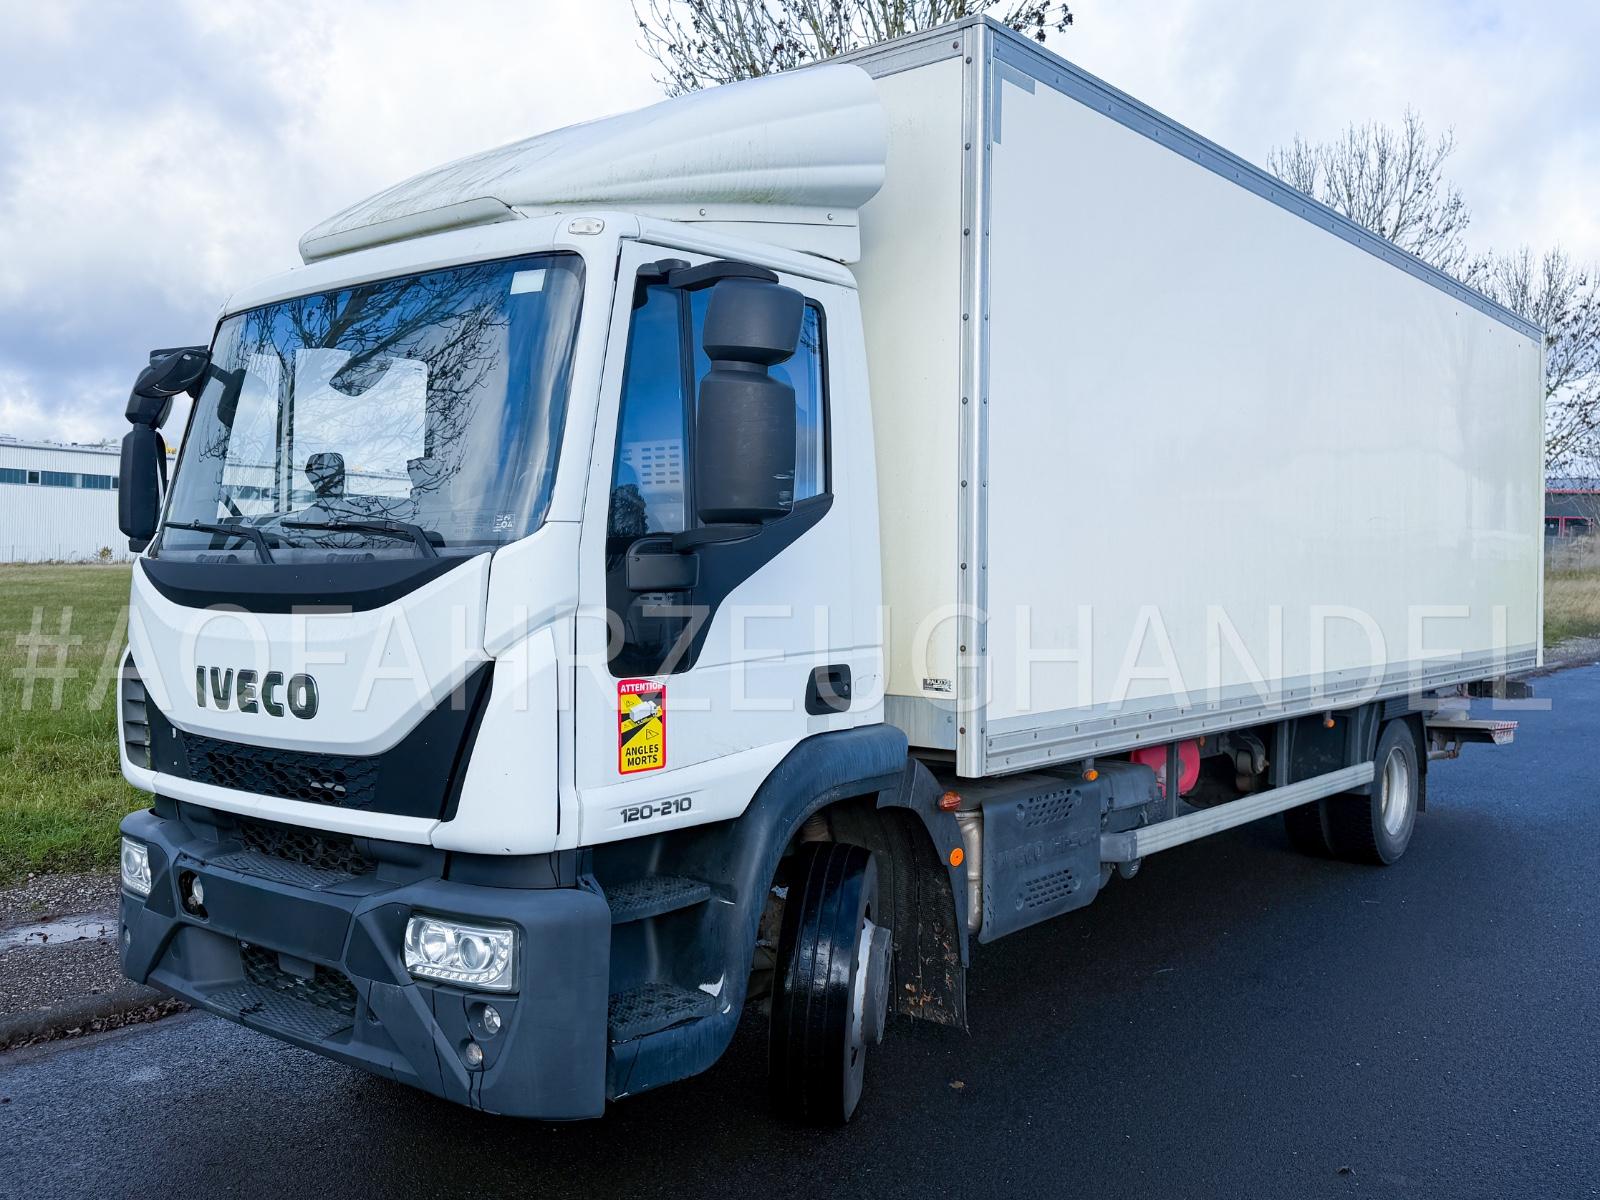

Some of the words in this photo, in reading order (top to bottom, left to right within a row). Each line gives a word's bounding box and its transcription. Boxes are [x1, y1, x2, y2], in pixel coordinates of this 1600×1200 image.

[196, 665, 319, 719] IVECO
[620, 682, 663, 693] ATTENTION
[625, 744, 659, 757] ANGLES
[627, 754, 658, 767] MORTS
[620, 797, 692, 823] 120-210
